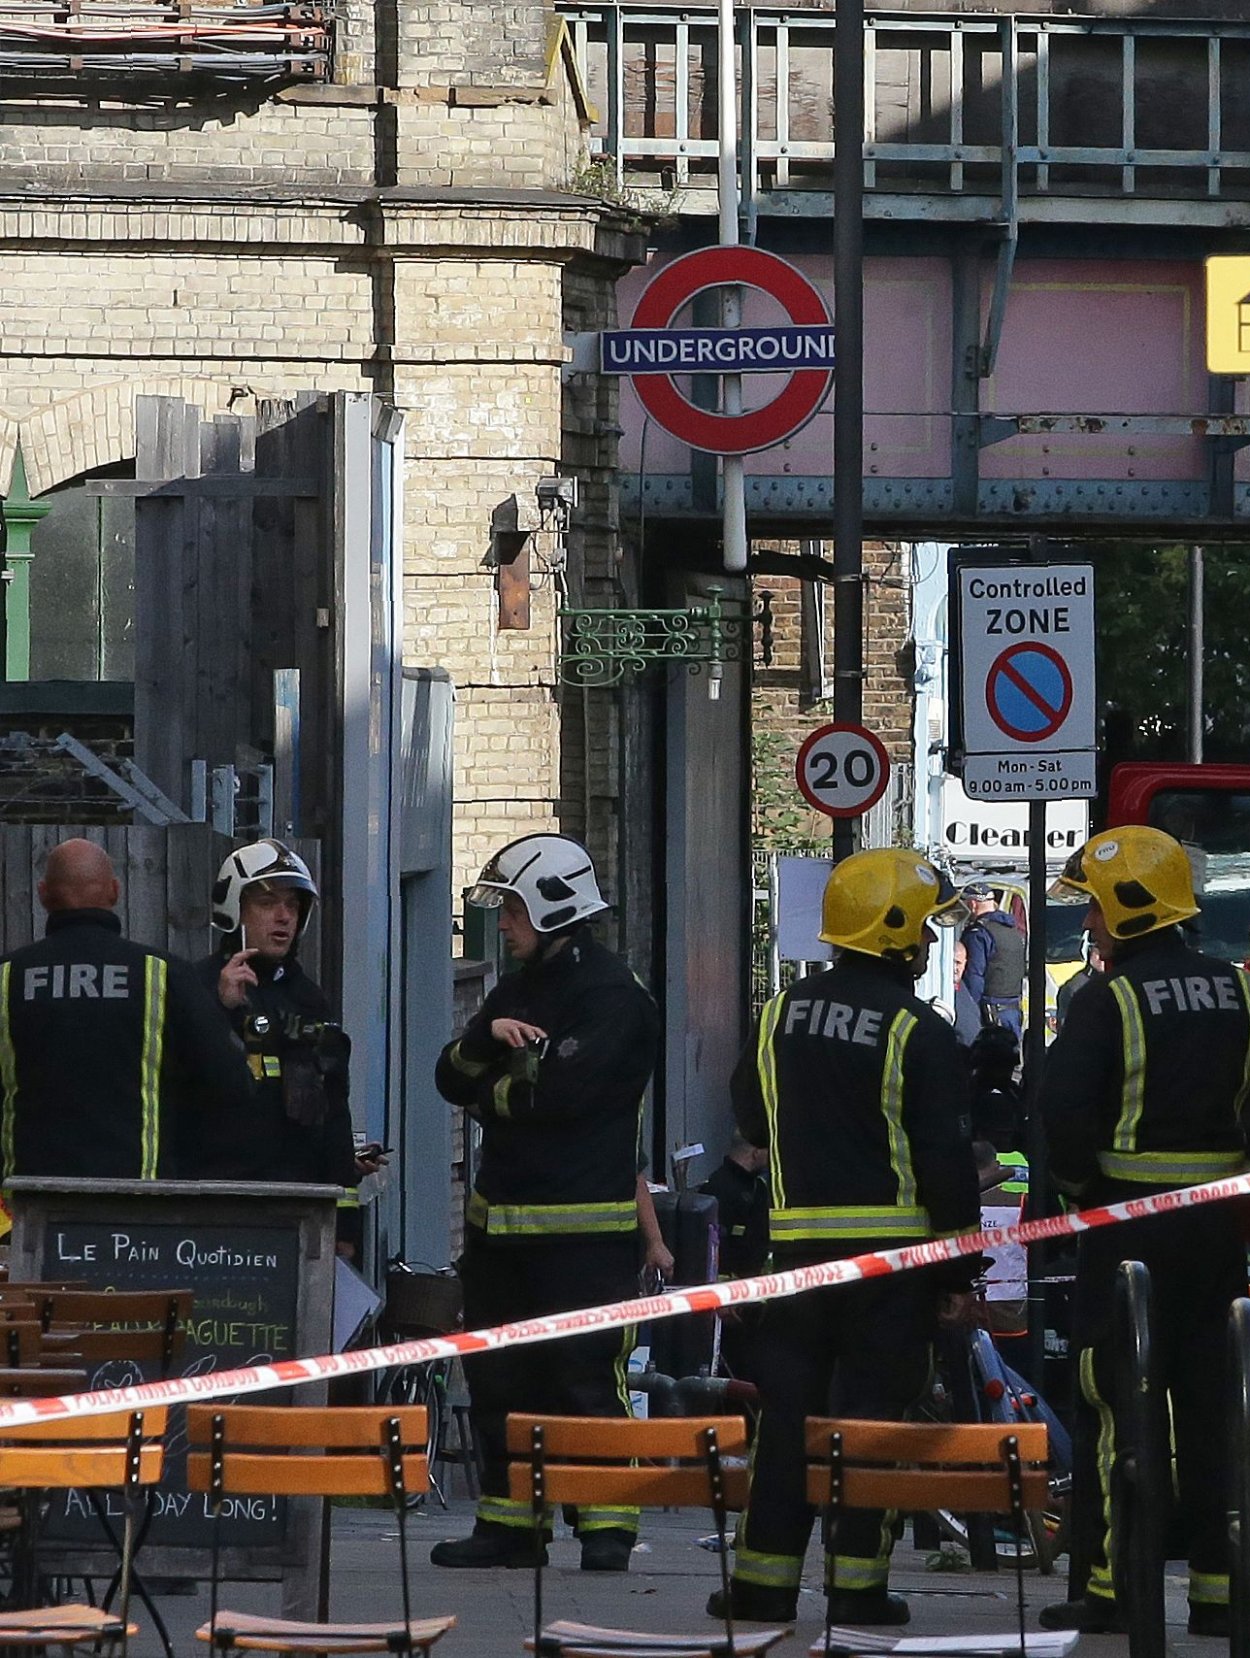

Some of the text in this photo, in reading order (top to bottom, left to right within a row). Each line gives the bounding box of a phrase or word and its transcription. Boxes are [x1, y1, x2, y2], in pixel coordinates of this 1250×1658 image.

[969, 577, 1086, 599] Controlled
[986, 607, 1070, 635] ZONE
[809, 749, 875, 790] 20
[969, 779, 1002, 794] 9.00
[1004, 783, 1025, 794] am
[1035, 778, 1069, 792] 5.00
[1071, 780, 1092, 791] pm
[24, 963, 130, 1001] FIRE
[1142, 976, 1240, 1016] FIRE
[784, 999, 884, 1047] FIRE
[65, 1488, 125, 1519] ALL
